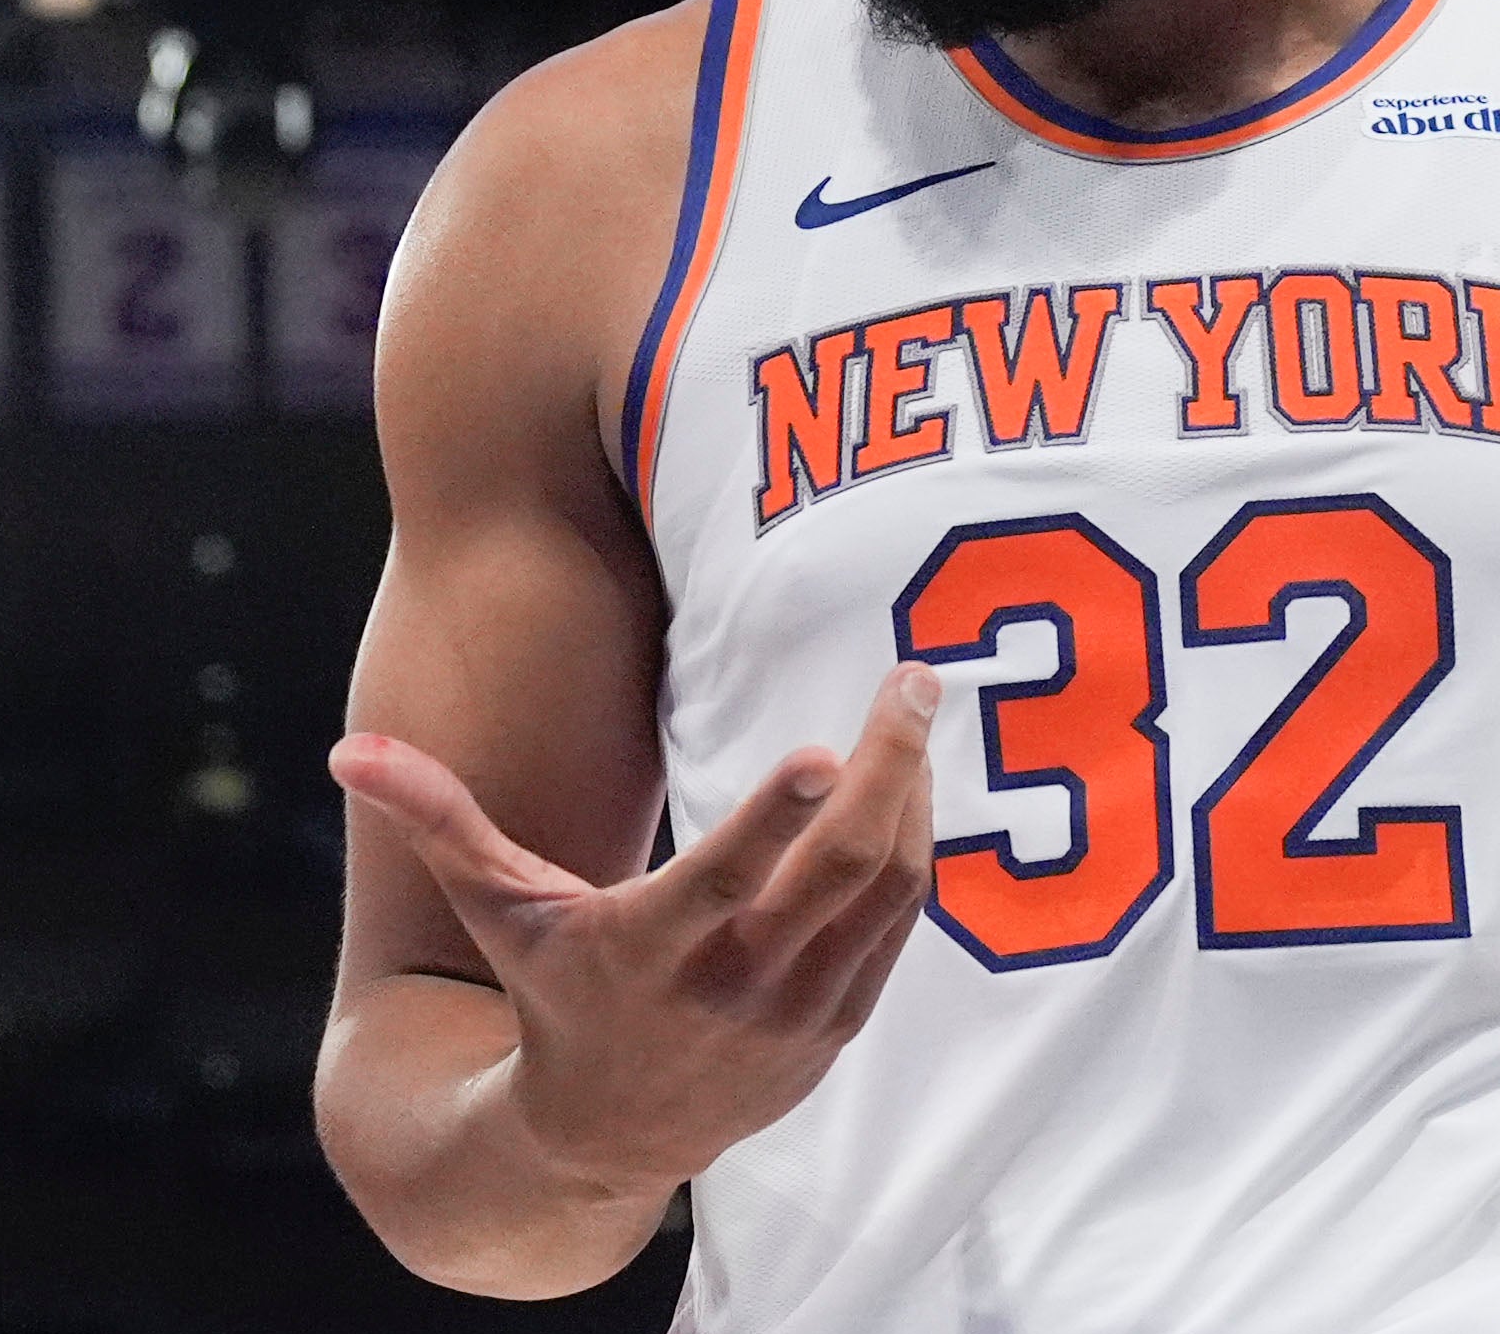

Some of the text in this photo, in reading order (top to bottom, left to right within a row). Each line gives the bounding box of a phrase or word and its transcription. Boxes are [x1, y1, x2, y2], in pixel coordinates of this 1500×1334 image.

[1372, 110, 1455, 136] abu
[1373, 93, 1487, 110] experience
[113, 227, 183, 343] 2
[748, 278, 1131, 538] NEW
[892, 493, 1471, 973] 32
